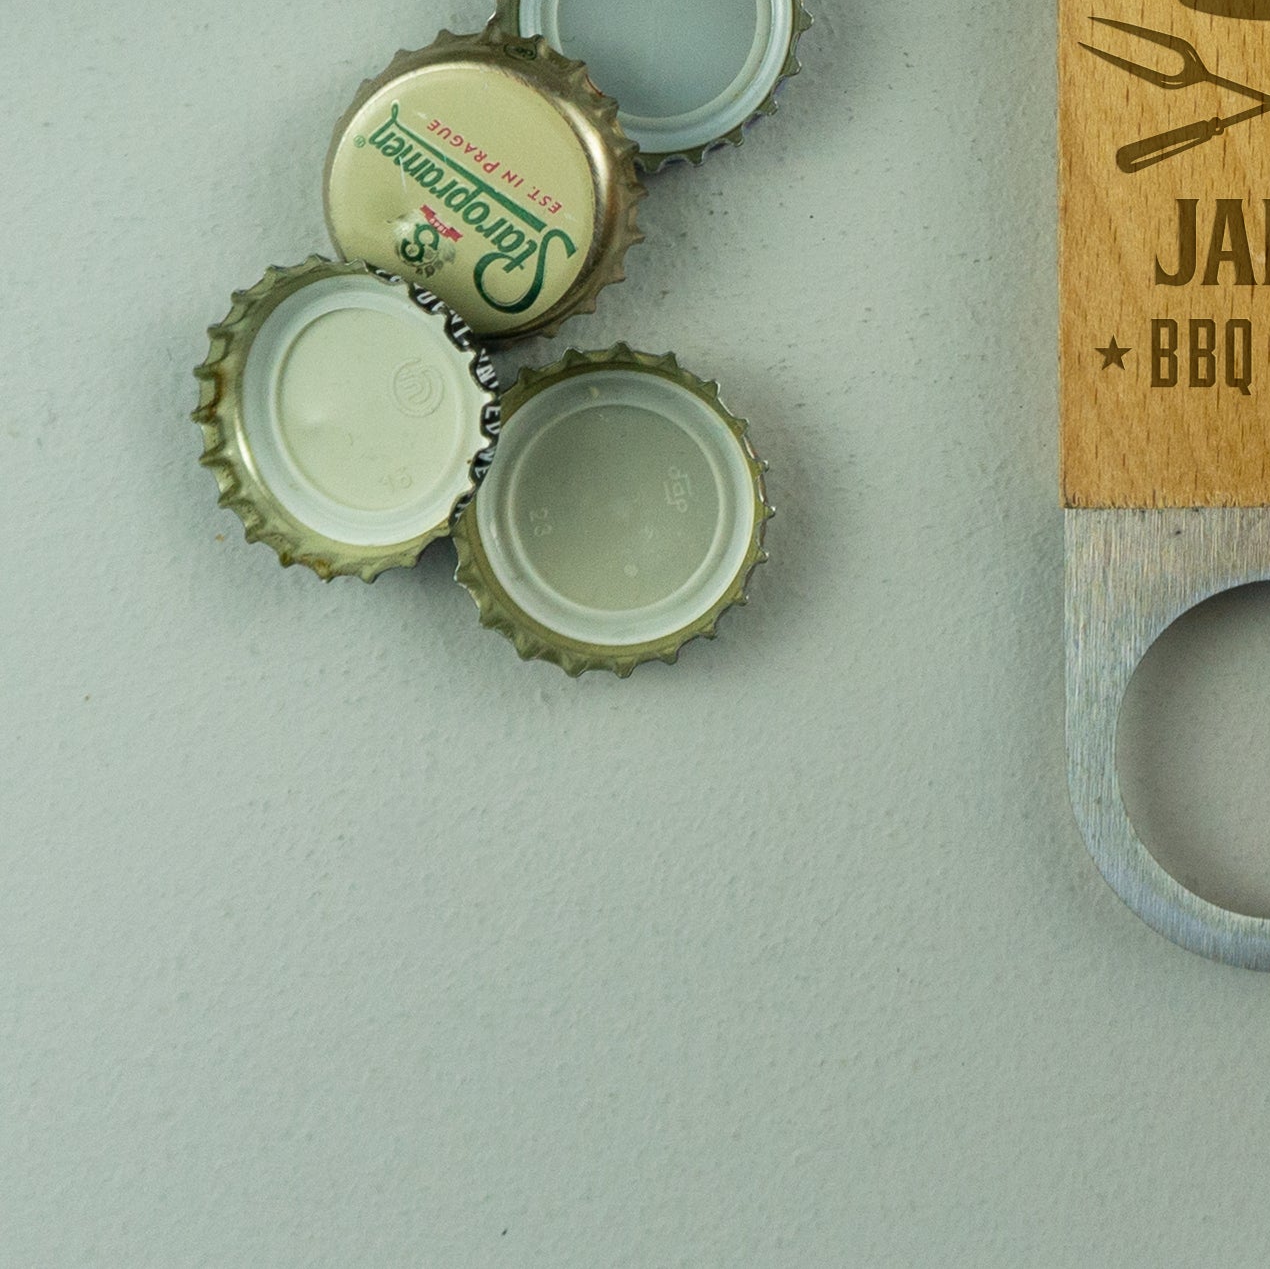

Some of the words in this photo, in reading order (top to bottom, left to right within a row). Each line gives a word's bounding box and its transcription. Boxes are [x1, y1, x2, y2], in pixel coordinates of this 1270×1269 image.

[427, 119, 500, 174] PRAGUE
[501, 170, 524, 188] IN
[526, 186, 562, 214] EST.
[1150, 318, 1253, 396] BBQ
